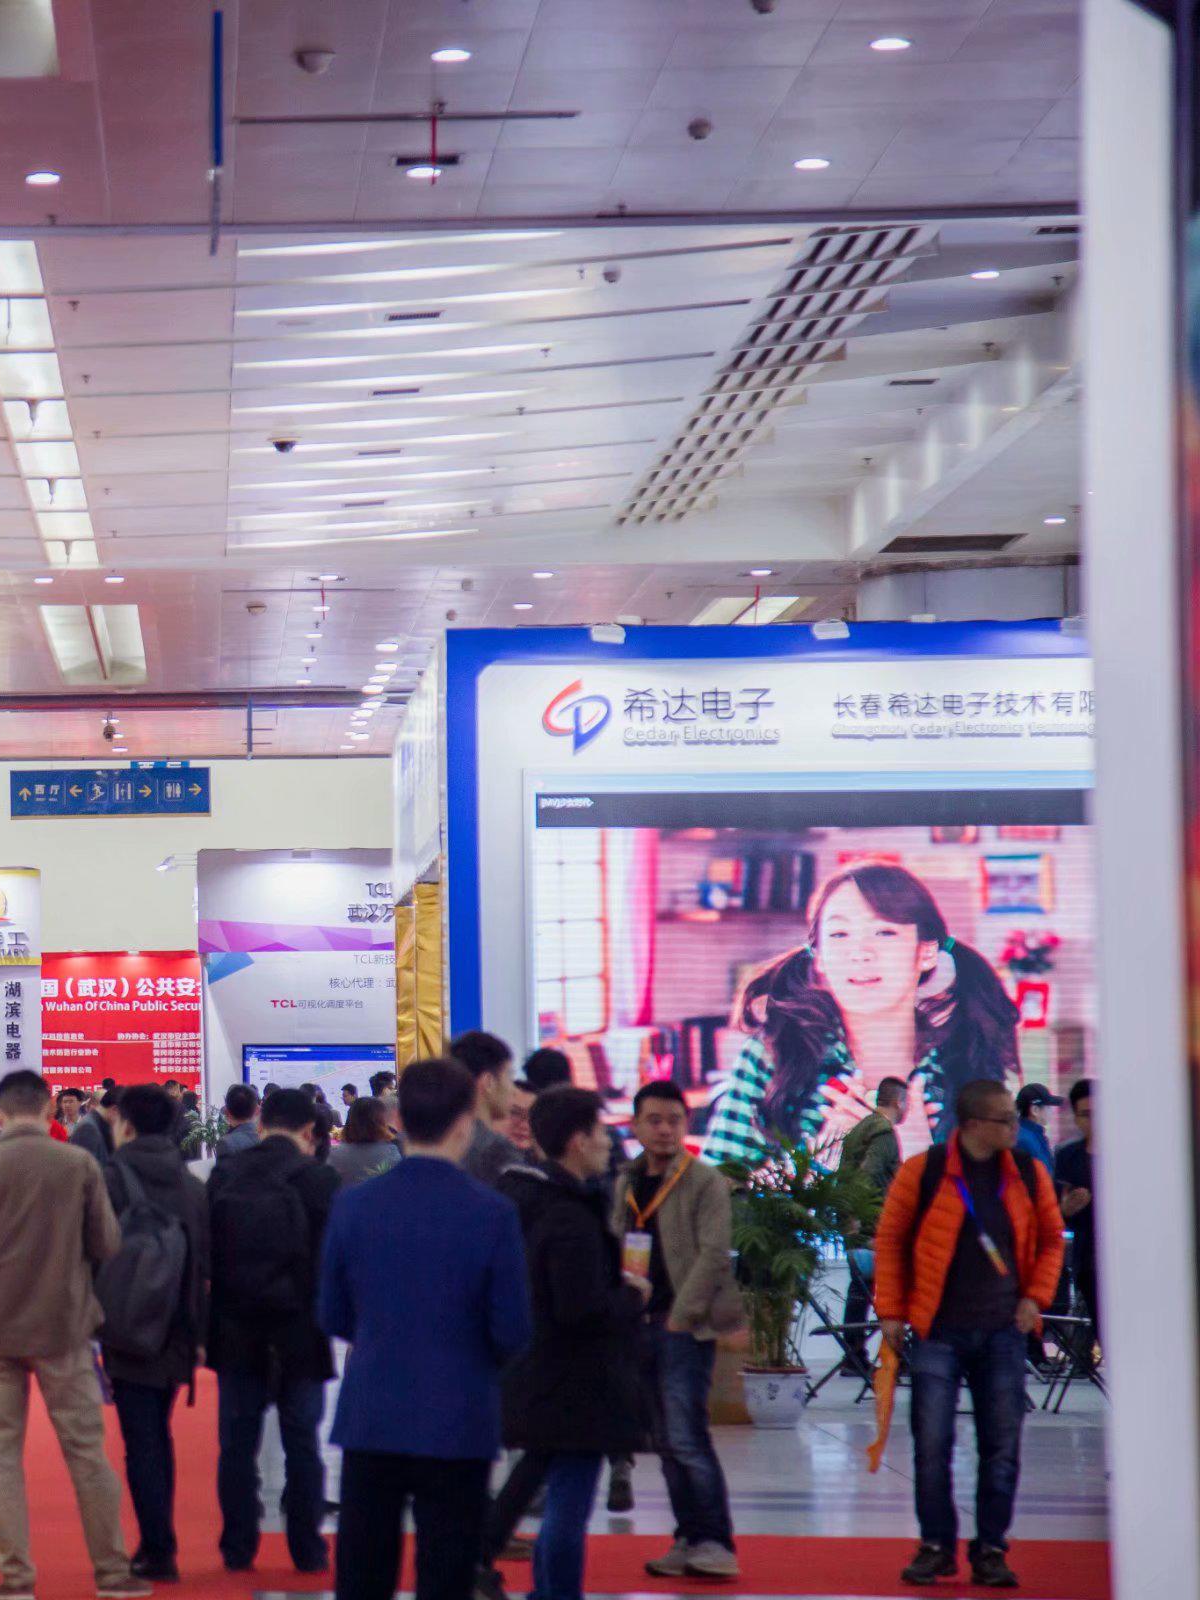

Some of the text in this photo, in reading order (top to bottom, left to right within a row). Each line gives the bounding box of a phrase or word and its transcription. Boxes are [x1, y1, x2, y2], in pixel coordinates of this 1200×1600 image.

[623, 687, 775, 722] 希达电子
[623, 725, 780, 744] Cedar Electronics
[955, 720, 1024, 737] Electronics
[366, 883, 392, 896] TCL
[41, 978, 201, 998] 国（武汉）公共安
[46, 1001, 84, 1011] Wuhan
[85, 1001, 100, 1011] Of
[100, 1000, 130, 1011] China
[132, 1000, 169, 1011] Public
[5, 981, 22, 1060] 湖滨电器
